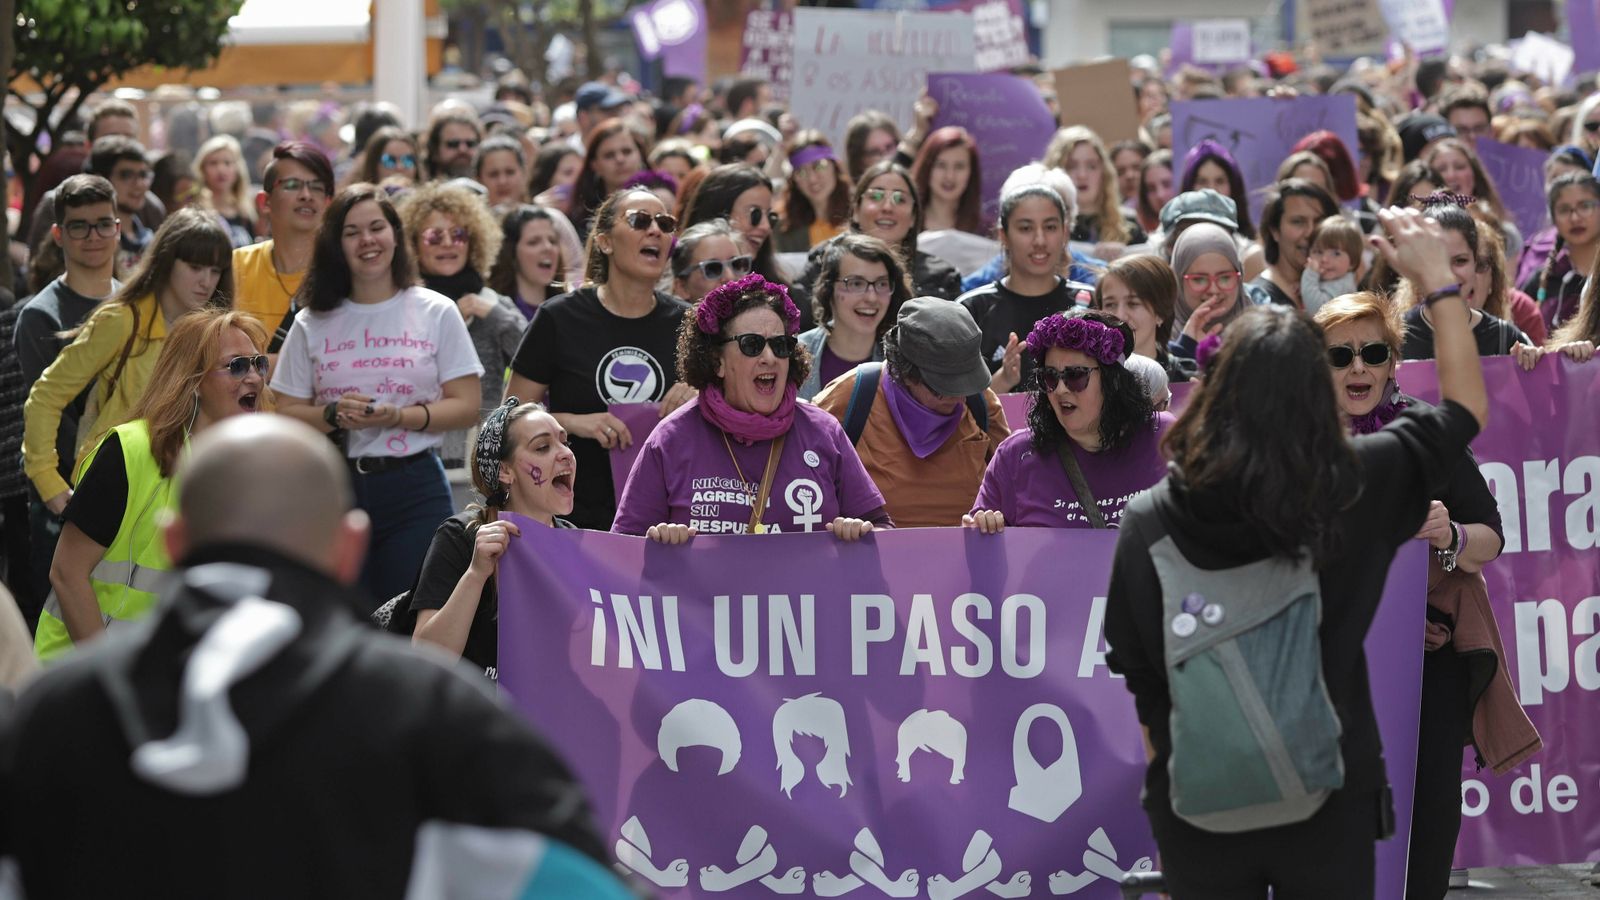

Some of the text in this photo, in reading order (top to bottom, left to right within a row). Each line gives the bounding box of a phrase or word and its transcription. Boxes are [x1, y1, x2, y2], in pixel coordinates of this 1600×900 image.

[324, 338, 356, 354] Los
[692, 491, 771, 508] AGRESI
[690, 504, 720, 517] SIN
[690, 520, 782, 535] RESPUETA
[589, 588, 687, 672] ¡NI
[713, 594, 816, 678] UN
[850, 592, 1047, 680] PASO
[1510, 763, 1579, 815] de
